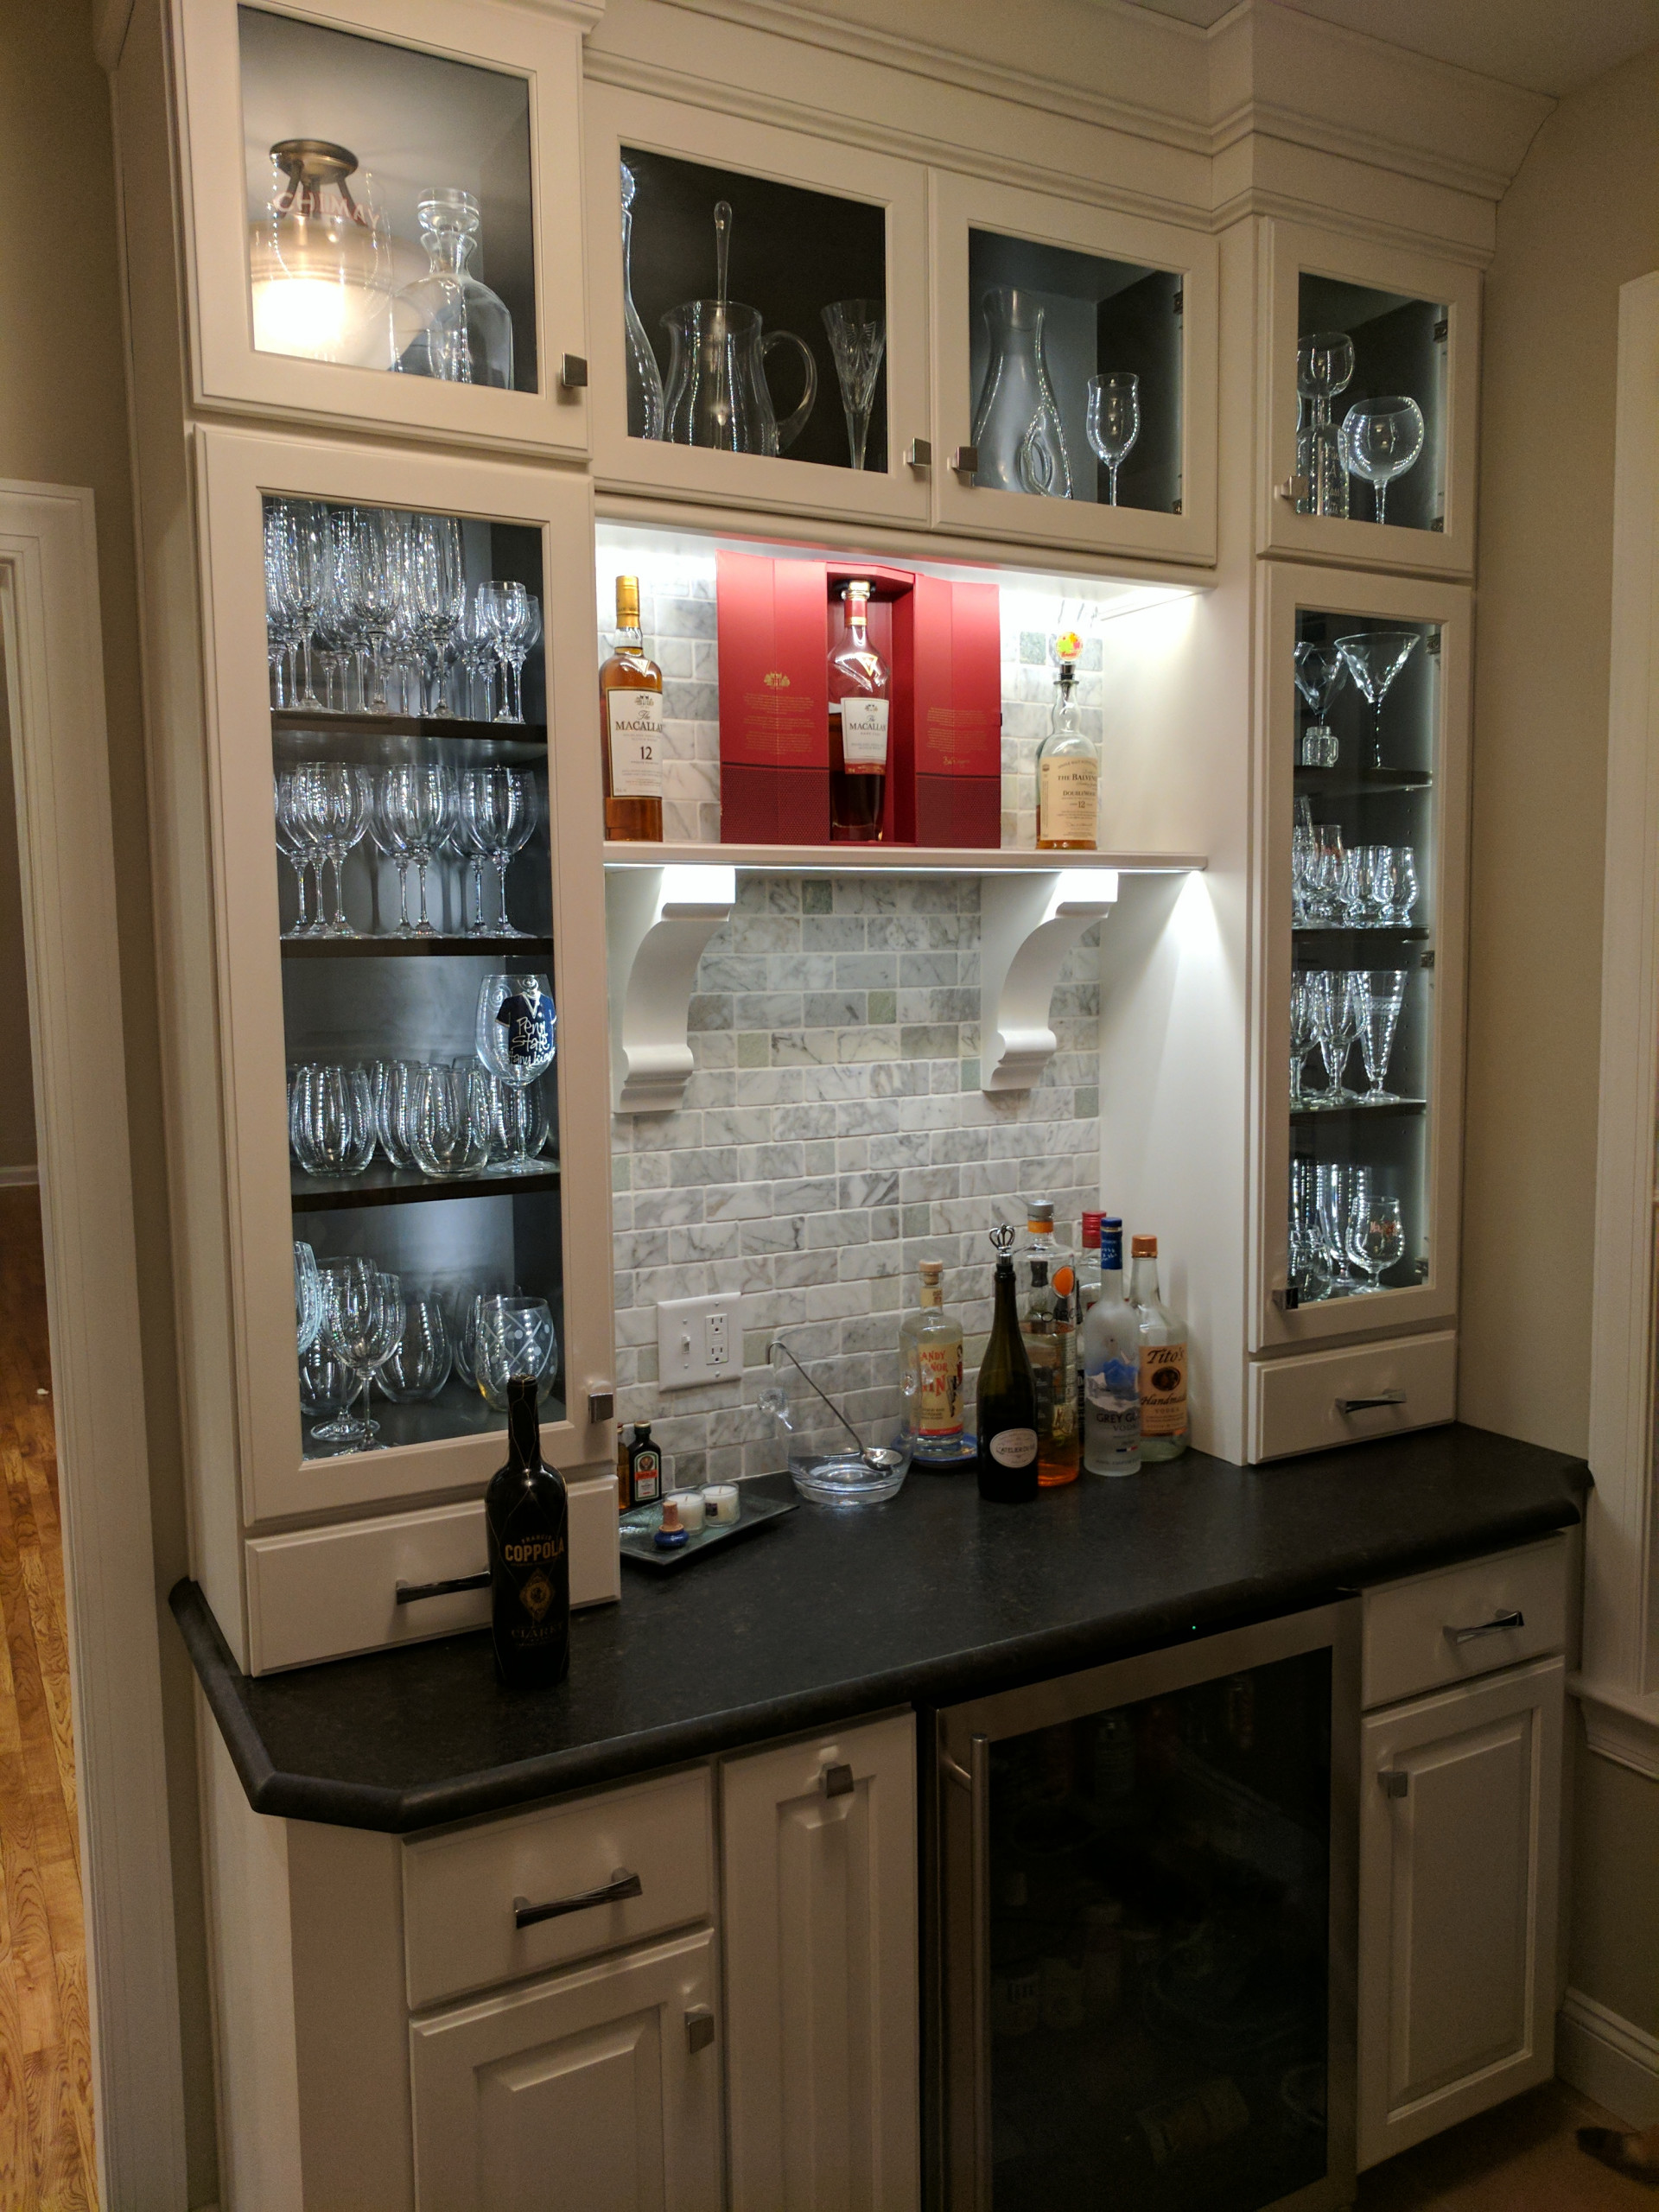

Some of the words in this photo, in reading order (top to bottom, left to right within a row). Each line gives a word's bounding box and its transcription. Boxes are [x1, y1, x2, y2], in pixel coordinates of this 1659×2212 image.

[272, 191, 380, 229] CHIMAY
[637, 709, 651, 720] The
[640, 746, 652, 760] 12
[1077, 800, 1086, 809] 12
[516, 1015, 546, 1035] Penn
[512, 1033, 550, 1052] State
[919, 1350, 946, 1363] ANDY
[1147, 1346, 1185, 1364] Tito's
[1096, 1413, 1122, 1423] GREY
[505, 1535, 565, 1562] COPPOLA
